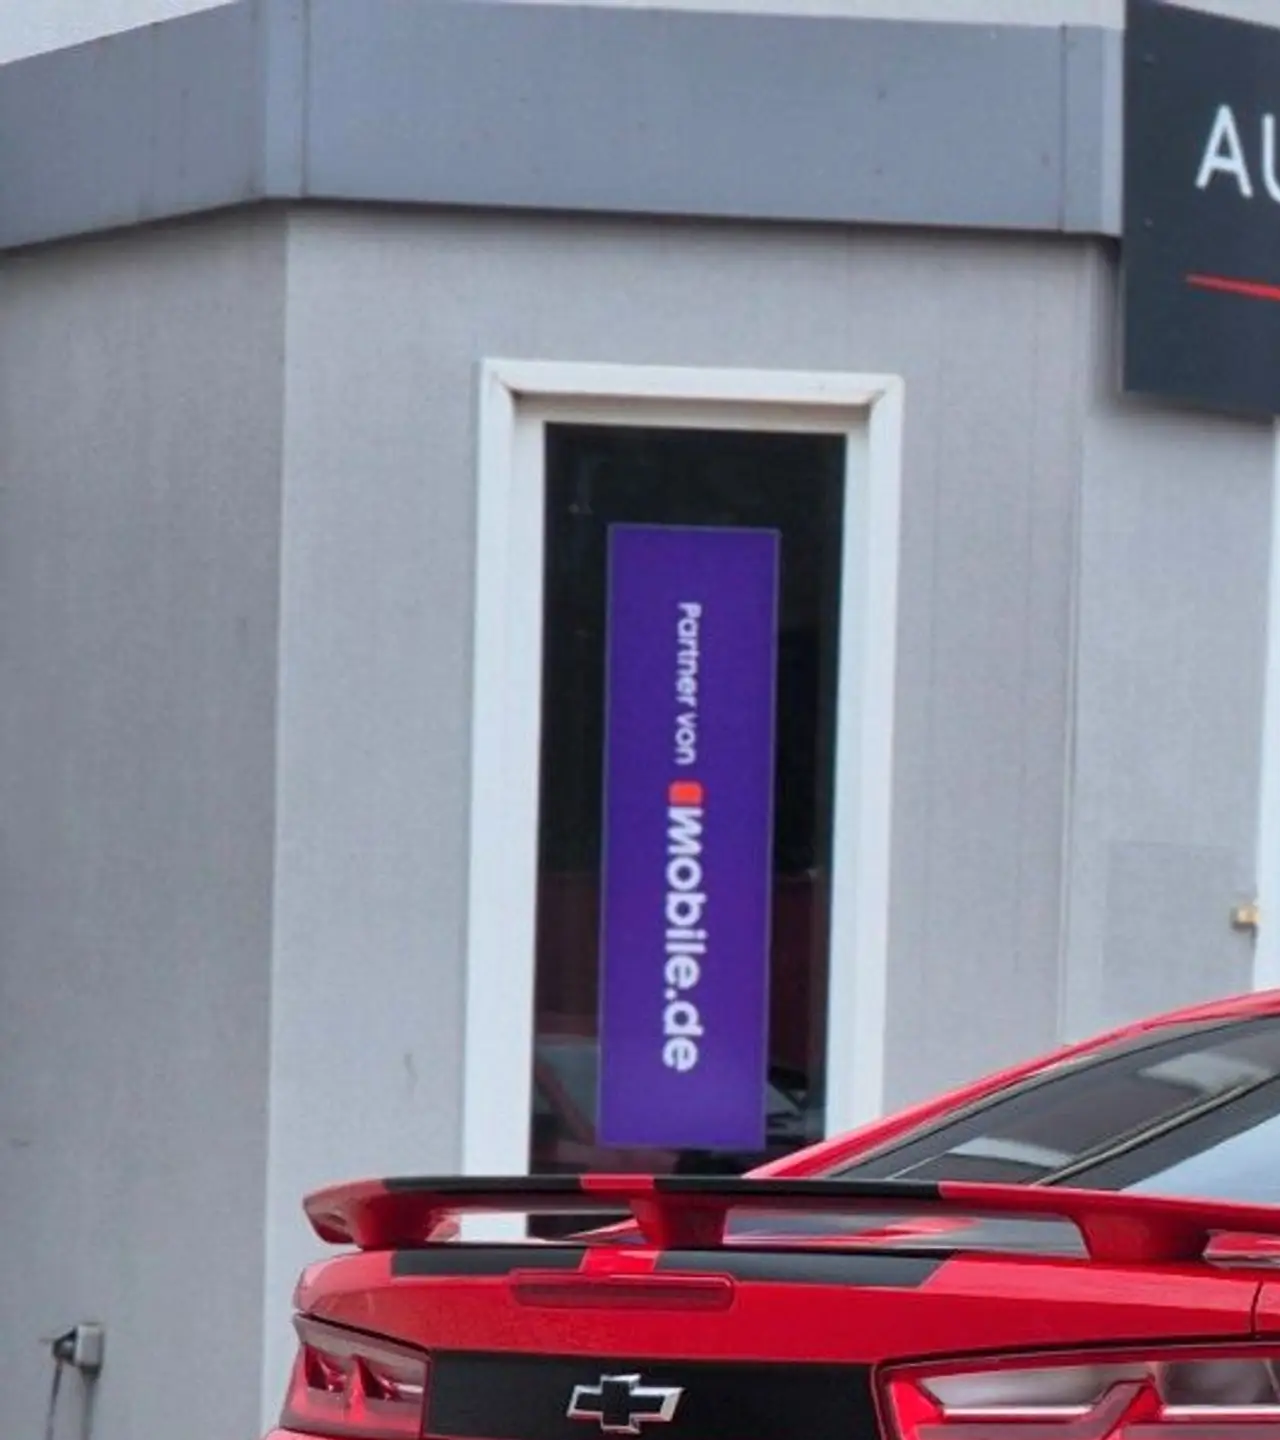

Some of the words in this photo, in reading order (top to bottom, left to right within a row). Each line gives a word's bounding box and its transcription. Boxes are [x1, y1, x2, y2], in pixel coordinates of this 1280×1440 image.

[674, 601, 703, 706] Partner
[673, 710, 699, 766] von
[662, 803, 708, 1074] mobile.de
